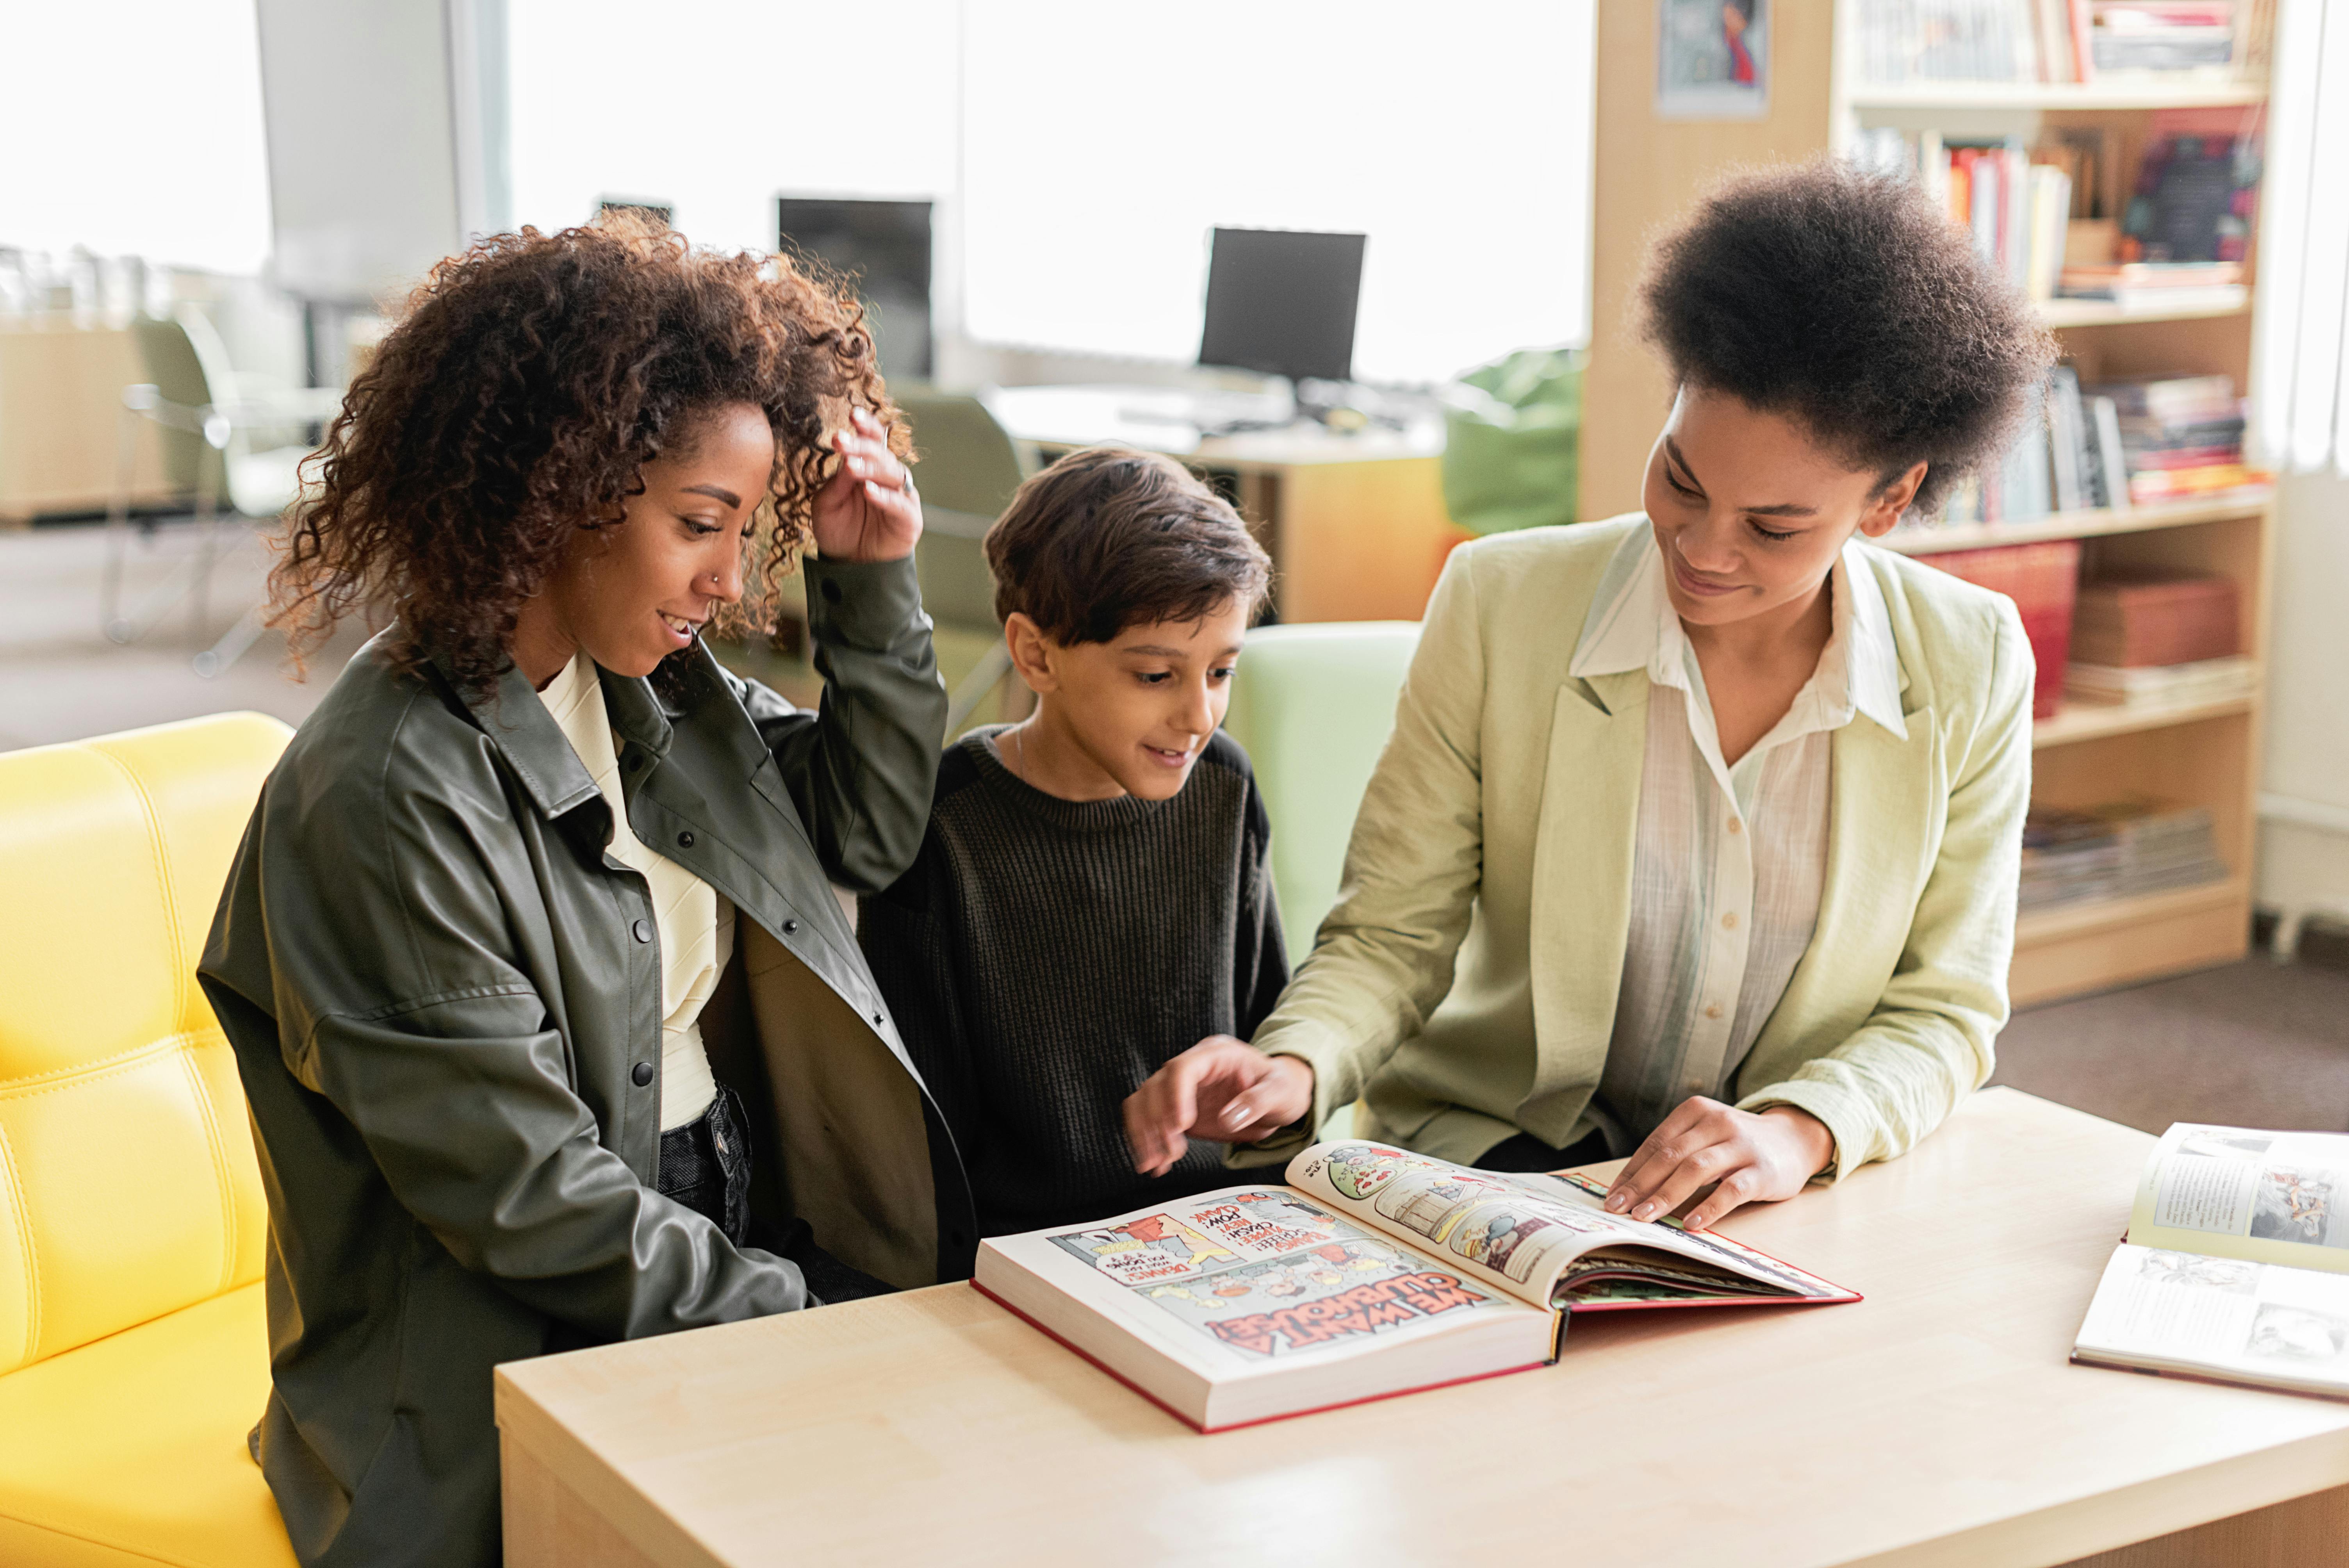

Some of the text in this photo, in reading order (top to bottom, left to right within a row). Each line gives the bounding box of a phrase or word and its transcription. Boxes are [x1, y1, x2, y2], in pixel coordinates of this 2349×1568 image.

[1308, 1166, 1321, 1177] The
[1190, 1205, 1239, 1223] CLANK
[1203, 1212, 1241, 1229] POW!
[1217, 1218, 1252, 1233] HEY!
[1223, 1222, 1273, 1240] CRASH!
[1235, 1226, 1289, 1246] YIPPEE!
[1251, 1228, 1309, 1251] SCREEEE!
[1275, 1231, 1331, 1253] BANG!
[1125, 1263, 1191, 1281] DENNIS!
[1204, 1271, 1463, 1342] CLUBHOUSE!
[1225, 1288, 1491, 1356] WE WANT A
